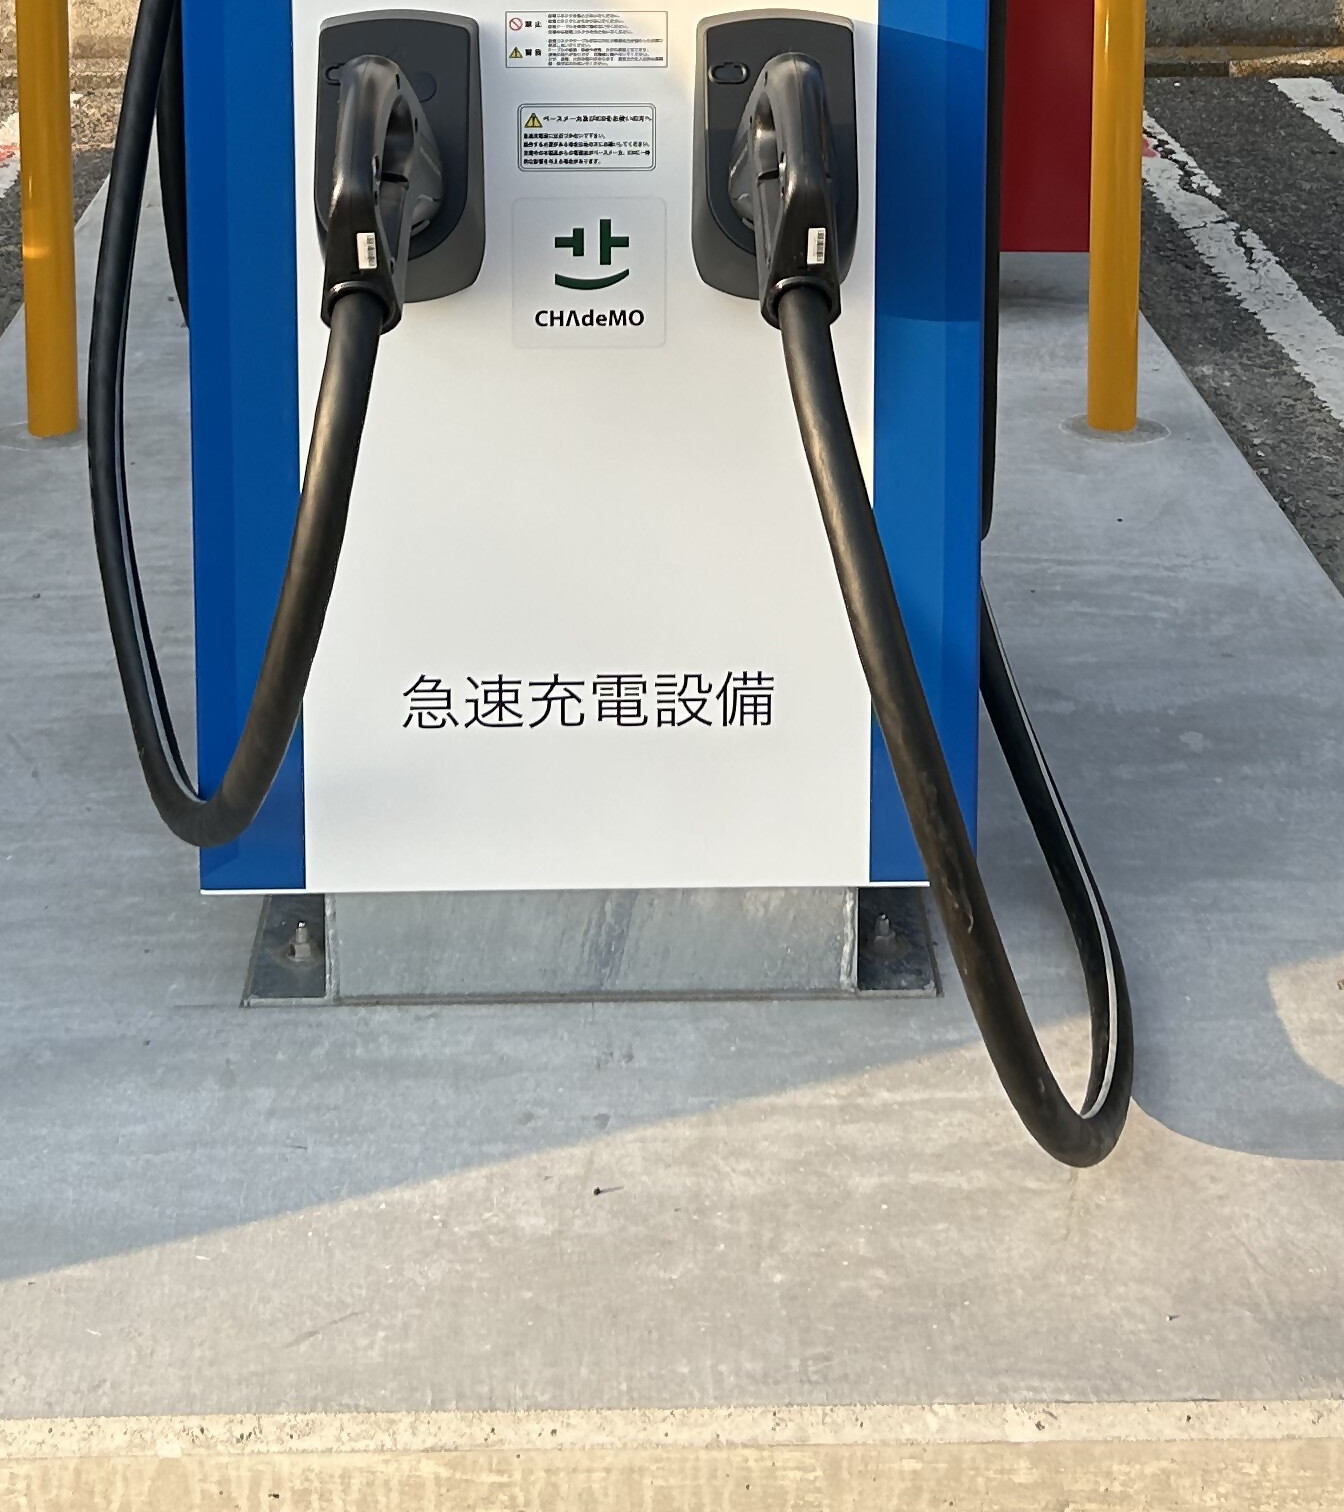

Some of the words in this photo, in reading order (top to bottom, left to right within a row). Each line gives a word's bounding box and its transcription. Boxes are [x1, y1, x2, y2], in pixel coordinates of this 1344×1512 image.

[534, 308, 645, 327] CHAdeMO
[401, 670, 775, 730] 急速充電設備
